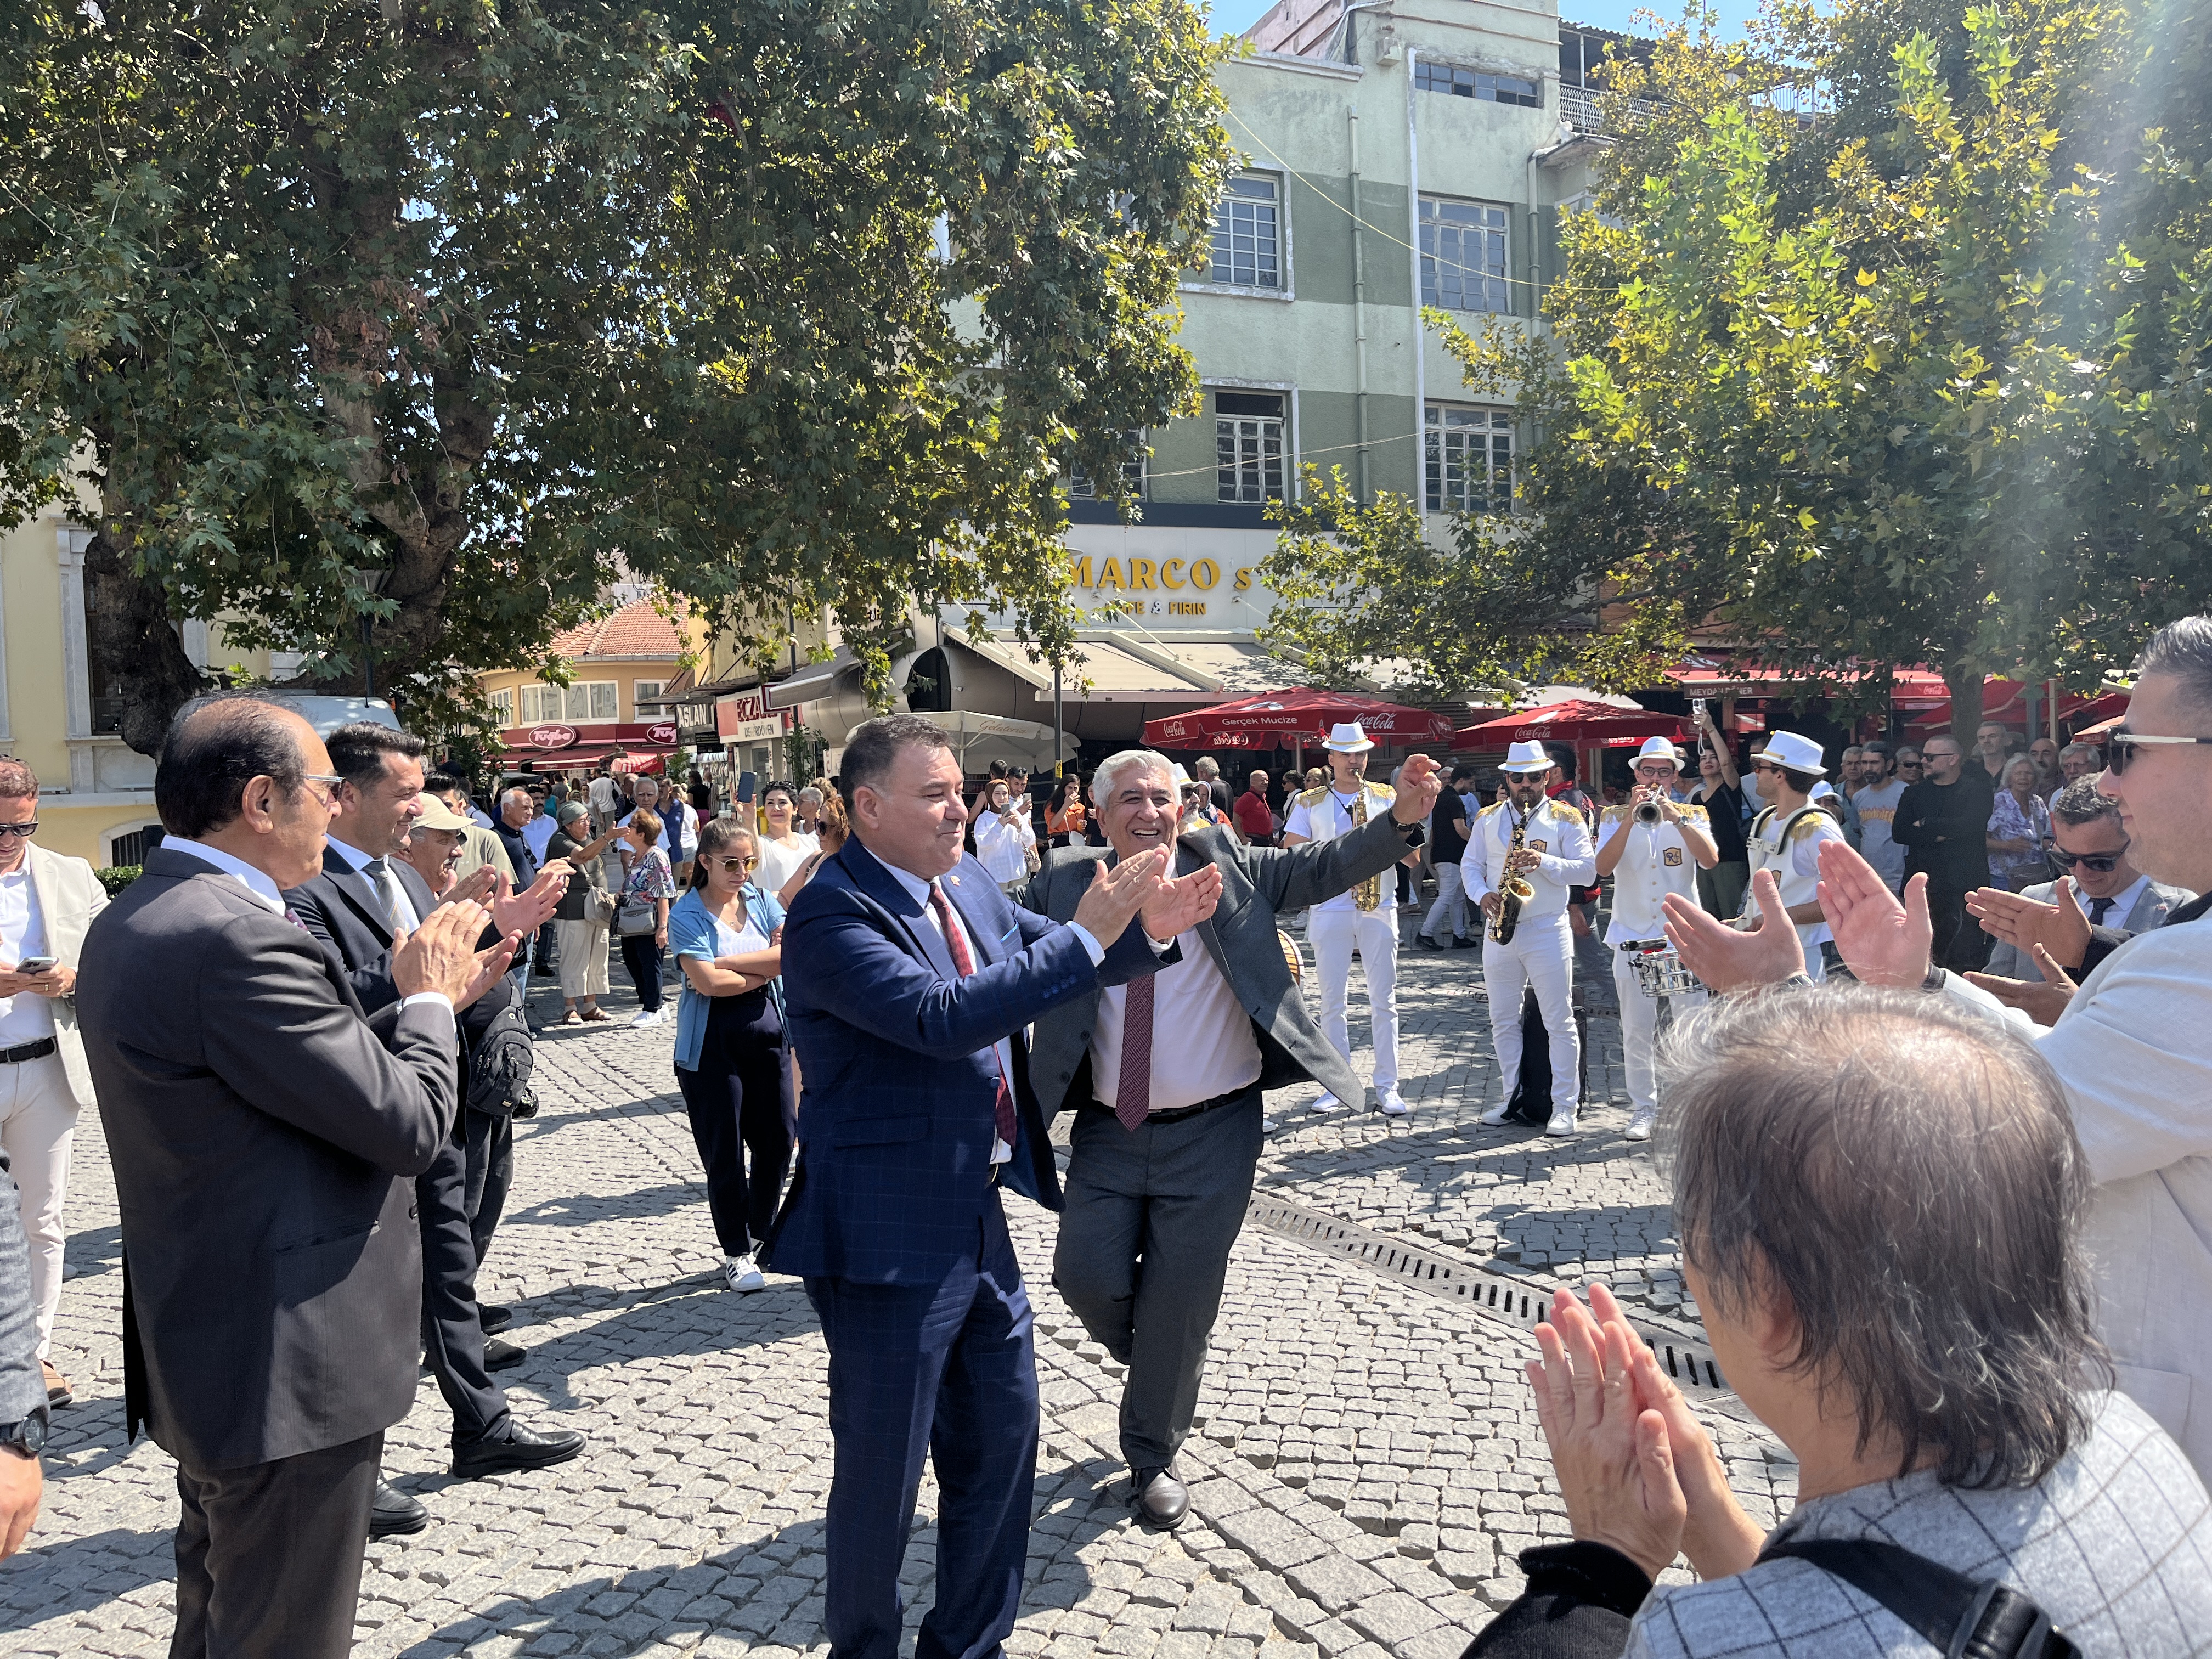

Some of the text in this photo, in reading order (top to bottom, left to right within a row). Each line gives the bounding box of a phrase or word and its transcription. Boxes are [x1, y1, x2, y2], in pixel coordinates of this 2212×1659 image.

[1068, 556, 1221, 590] MARCO
[1151, 601, 1163, 614] &
[1169, 602, 1206, 615] FIRIN
[737, 696, 777, 722] ECZA
[1222, 716, 1297, 726] Gerçek Mucize
